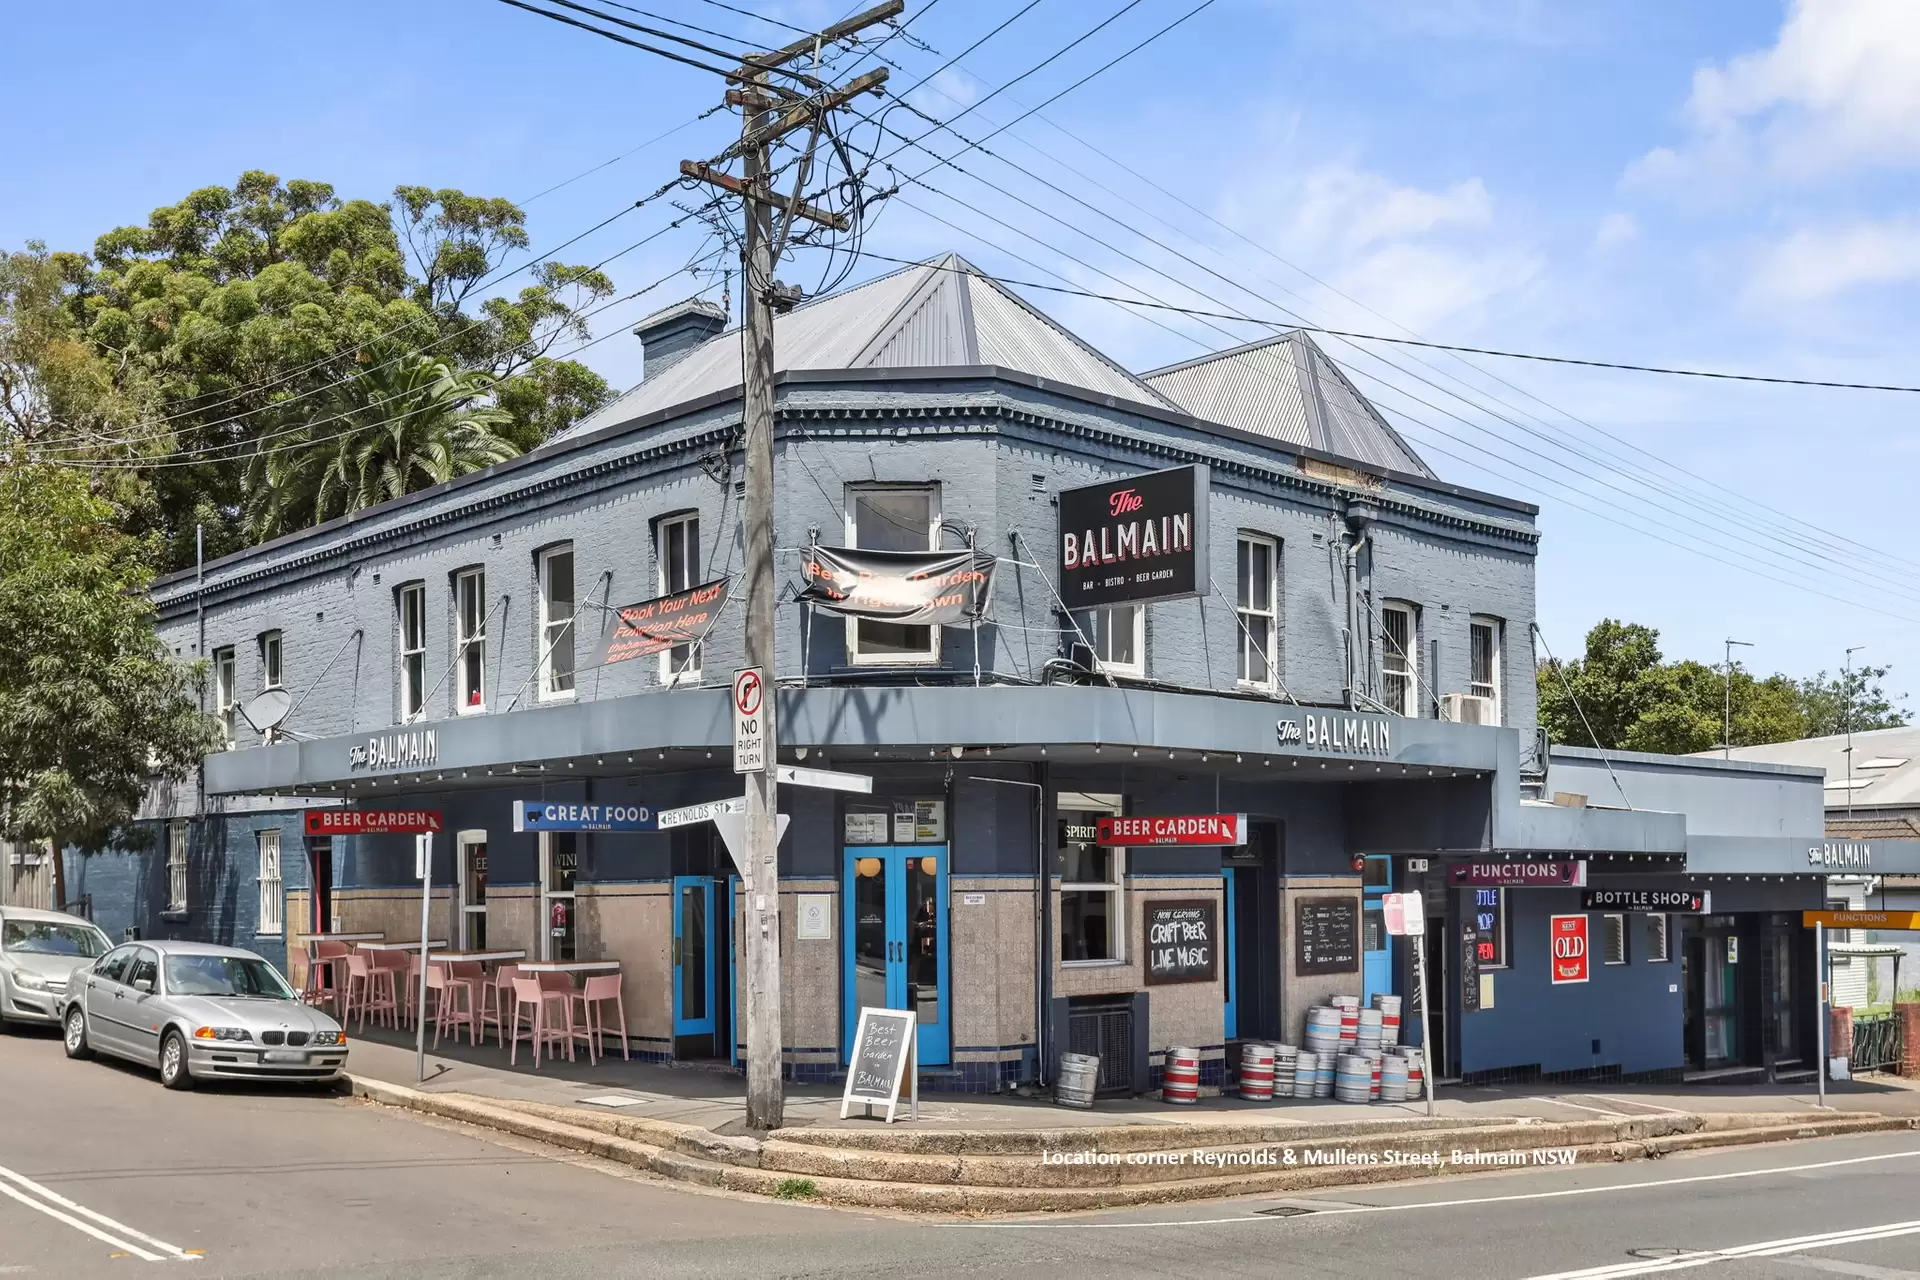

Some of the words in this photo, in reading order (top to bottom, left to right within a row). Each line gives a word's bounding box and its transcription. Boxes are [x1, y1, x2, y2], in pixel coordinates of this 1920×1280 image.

[1109, 489, 1143, 516] The
[1064, 512, 1191, 570] BALMAIN
[1083, 581, 1094, 590] BAR
[1105, 577, 1125, 588] BISTRO
[1136, 573, 1150, 583] BEER
[1152, 569, 1174, 579] GARDEN
[621, 603, 653, 623] Book
[659, 594, 688, 616] Your
[690, 586, 720, 607] Next
[614, 621, 673, 640] Function
[676, 612, 708, 629] Here
[742, 720, 757, 735] NO
[1277, 720, 1301, 741] The
[1306, 715, 1389, 751] BALMAIN
[350, 746, 367, 765] The
[369, 730, 437, 765] BALMAIN
[738, 738, 761, 751] RIGHT
[739, 755, 761, 765] TURN
[324, 813, 361, 826] BEER
[367, 812, 426, 826] GARDEN
[545, 804, 599, 822] GREAT
[605, 804, 649, 822] FOOD
[667, 806, 709, 825] REYNOLDS
[714, 804, 724, 813] ST
[1066, 825, 1097, 838] SPIRIT
[1114, 819, 1150, 836] BEER
[1155, 818, 1218, 835] GARDEN
[1824, 843, 1870, 866] BALMAIN
[1473, 863, 1558, 878] FUNCTIONS
[1595, 892, 1647, 904] BOTTLE
[1652, 893, 1690, 905] SHOP
[1833, 913, 1888, 922] FUNCTIONS
[1151, 921, 1181, 944] CRAFT
[1182, 921, 1207, 941] BEER
[1477, 942, 1494, 959] PEN
[1555, 936, 1585, 959] OLD
[1152, 948, 1175, 971] LIVE
[1177, 946, 1208, 966] MUSIC
[868, 1022, 896, 1035] Best
[865, 1036, 898, 1047] Beer
[862, 1047, 893, 1060] Garden
[856, 1070, 894, 1089] BALMAIN
